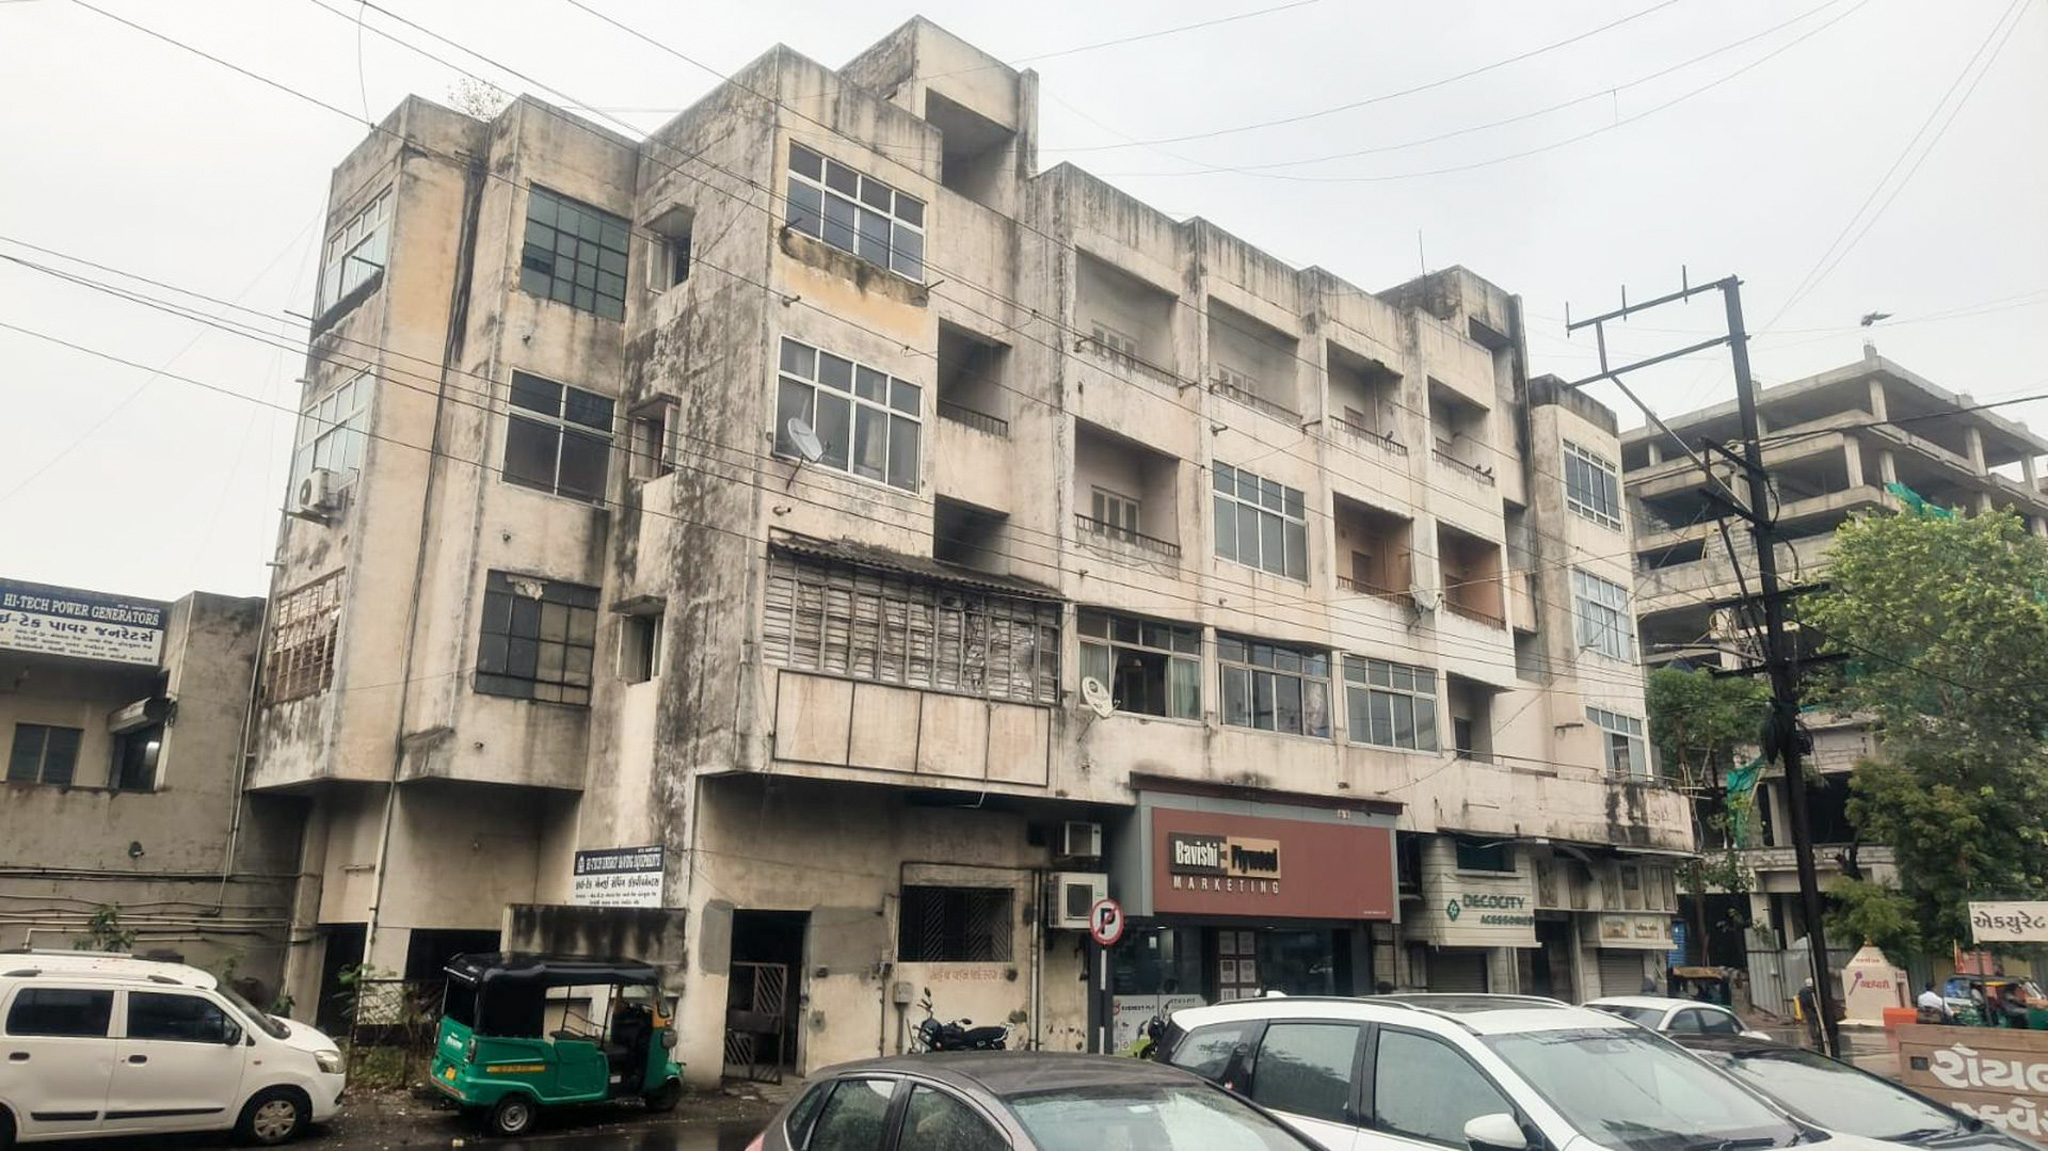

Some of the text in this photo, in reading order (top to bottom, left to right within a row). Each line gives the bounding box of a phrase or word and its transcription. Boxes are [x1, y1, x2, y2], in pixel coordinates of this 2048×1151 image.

[4, 593, 50, 611] HI-TECH
[52, 600, 89, 616] POWER
[91, 605, 159, 626] GENERATORS
[49, 620, 88, 634] પાવર
[1175, 840, 1278, 874] Bavishi Plywood
[1173, 875, 1279, 894] MARKETING
[1462, 894, 1525, 909] DECOCITY
